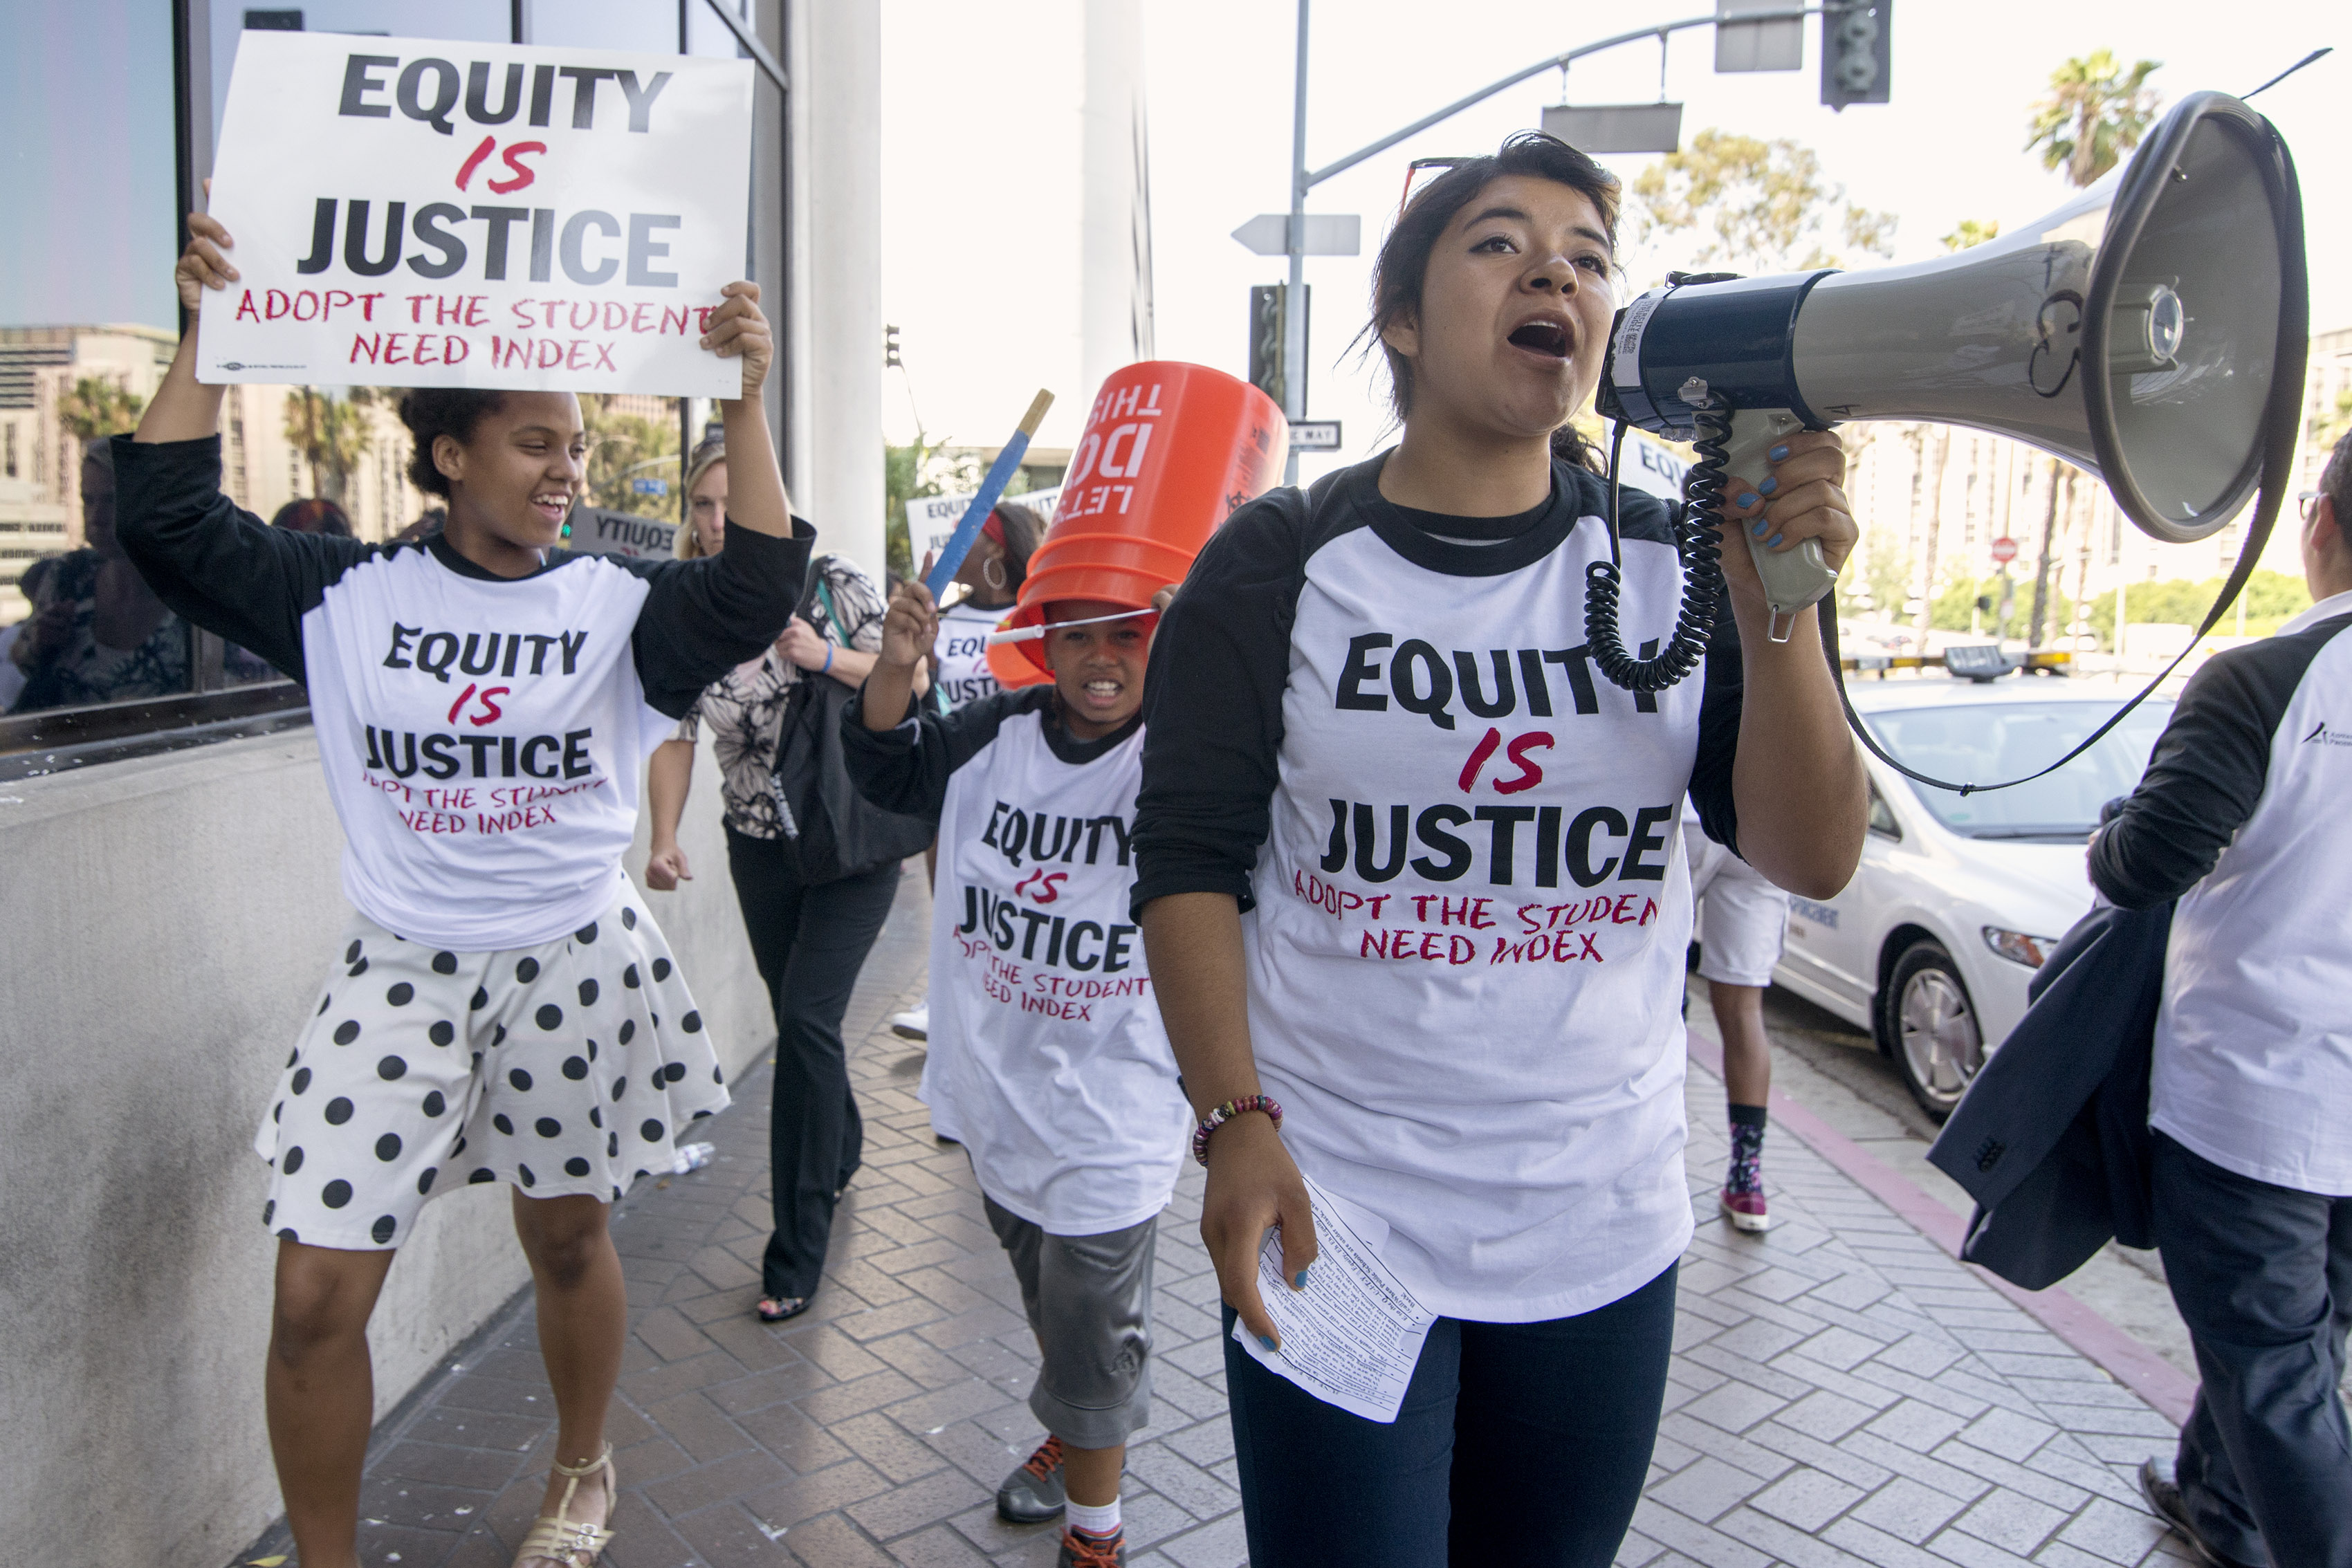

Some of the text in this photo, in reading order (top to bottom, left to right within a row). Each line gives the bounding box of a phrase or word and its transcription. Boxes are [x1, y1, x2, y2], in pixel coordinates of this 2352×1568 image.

[338, 53, 673, 135] EQUITY
[456, 136, 546, 194] IS
[297, 198, 681, 287] JUSTICE
[236, 289, 717, 335] ADOPT THE STUDENT
[349, 333, 617, 371] NEED INDEX
[1305, 430, 1331, 440] WAY
[1065, 423, 1153, 490] DO
[383, 621, 588, 683] EQUITY
[1335, 632, 1659, 730] EQUITY
[448, 683, 510, 726] IS
[366, 724, 592, 780] JUSTICE
[1458, 727, 1555, 794] IS
[423, 787, 477, 809] THE
[477, 804, 556, 834] INDEX
[982, 800, 1132, 867] EQUITY
[1321, 798, 1673, 888] JUSTICE
[1015, 867, 1068, 904] IS
[1294, 869, 1662, 934] ADOPT THE STUDEN
[960, 885, 1137, 973] JUSTICE
[1360, 928, 1604, 966] NEED INDEX
[992, 956, 1022, 984] THE
[1034, 973, 1150, 999] STUDENT
[1022, 992, 1091, 1022] INDEX
[1317, 1210, 1334, 1229] attack,
[1313, 1218, 1330, 1237] Equity
[1331, 1228, 1346, 1244] under
[1345, 1243, 1354, 1253] are
[1320, 1249, 1334, 1264] Justice
[1352, 1252, 1372, 1273] Schools
[1333, 1282, 1341, 1290] say
[1341, 1282, 1350, 1291] you
[1370, 1271, 1386, 1287] Public
[1313, 1284, 1322, 1293] say
[1332, 1289, 1341, 1298] you
[1340, 1289, 1350, 1298] you
[1352, 1284, 1361, 1293] you
[1322, 1292, 1332, 1302] you
[1289, 1302, 1305, 1319] equity
[1315, 1302, 1329, 1315] never
[1331, 1301, 1349, 1318] youth,
[1386, 1302, 1396, 1311] the
[1283, 1305, 1303, 1324] student
[1329, 1315, 1340, 1325] will
[1349, 1316, 1358, 1325] say
[1371, 1318, 1379, 1326] say
[1302, 1324, 1312, 1334] the
[1339, 1324, 1358, 1340] United
[1369, 1322, 1377, 1330] say
[1384, 1324, 1399, 1338] When
[1386, 1319, 1402, 1333] When
[1298, 1329, 1312, 1343] them
[1361, 1327, 1377, 1341] when
[1379, 1332, 1395, 1346] When
[1381, 1328, 1397, 1343] When
[1312, 1343, 1321, 1352] tell
[1343, 1343, 1357, 1356] with
[1358, 1339, 1375, 1354] Youth
[1377, 1339, 1393, 1354] (call)
[1345, 1354, 1355, 1362] for
[1345, 1361, 1356, 1369] the
[1376, 1353, 1387, 1362] The
